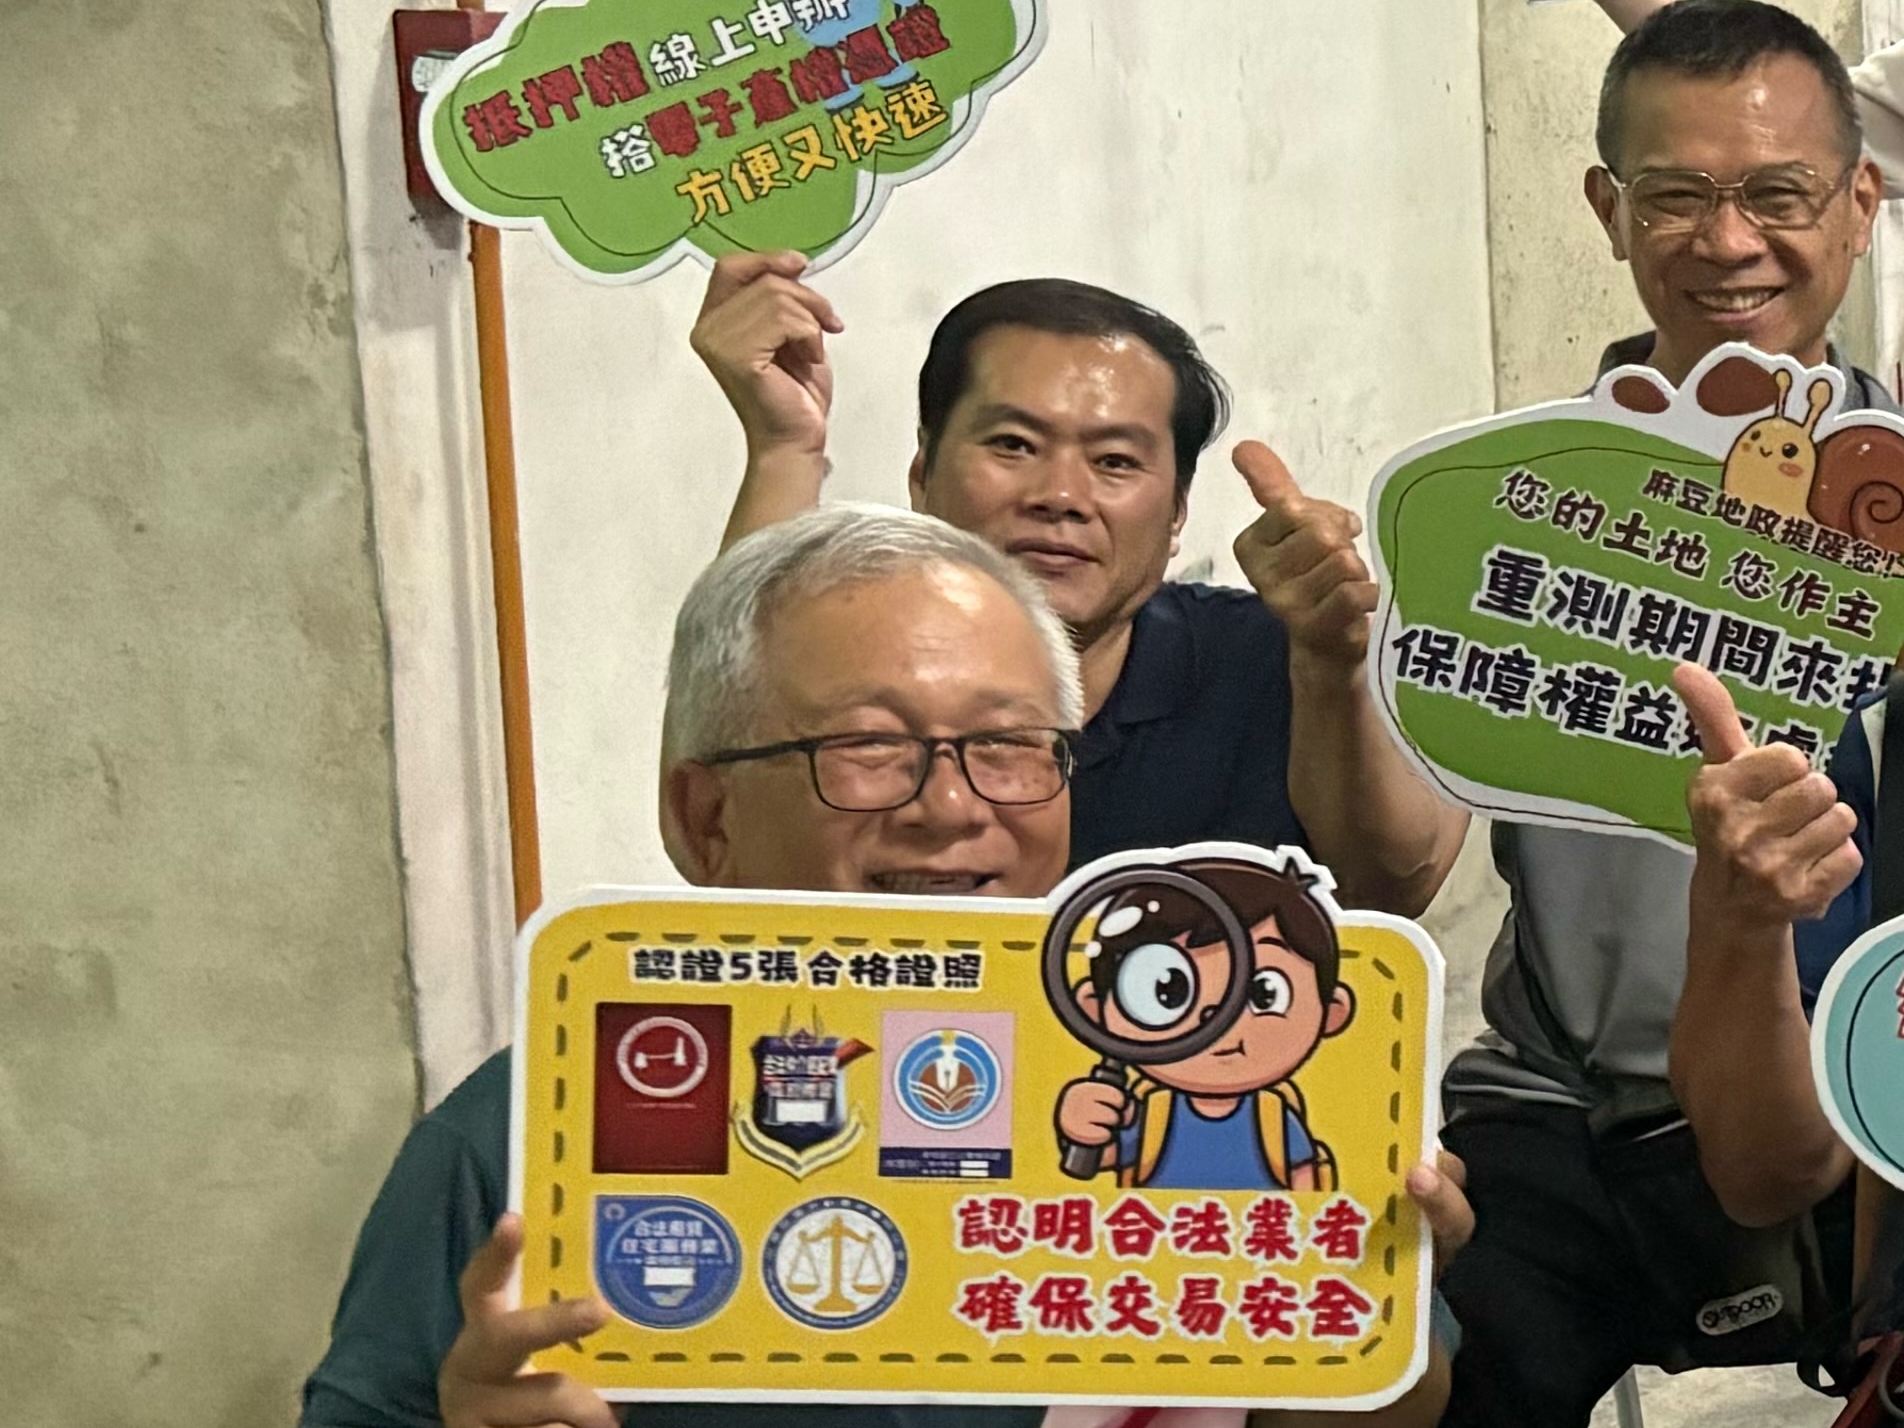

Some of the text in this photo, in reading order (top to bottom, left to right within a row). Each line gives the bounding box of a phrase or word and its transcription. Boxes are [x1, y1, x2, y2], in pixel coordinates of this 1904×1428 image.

[675, 77, 949, 224] 方便又快速
[1496, 470, 1883, 640] 您的土地 您作主
[952, 1194, 1374, 1264] 認明合法業者
[953, 1274, 1374, 1341] 確保交易安全
